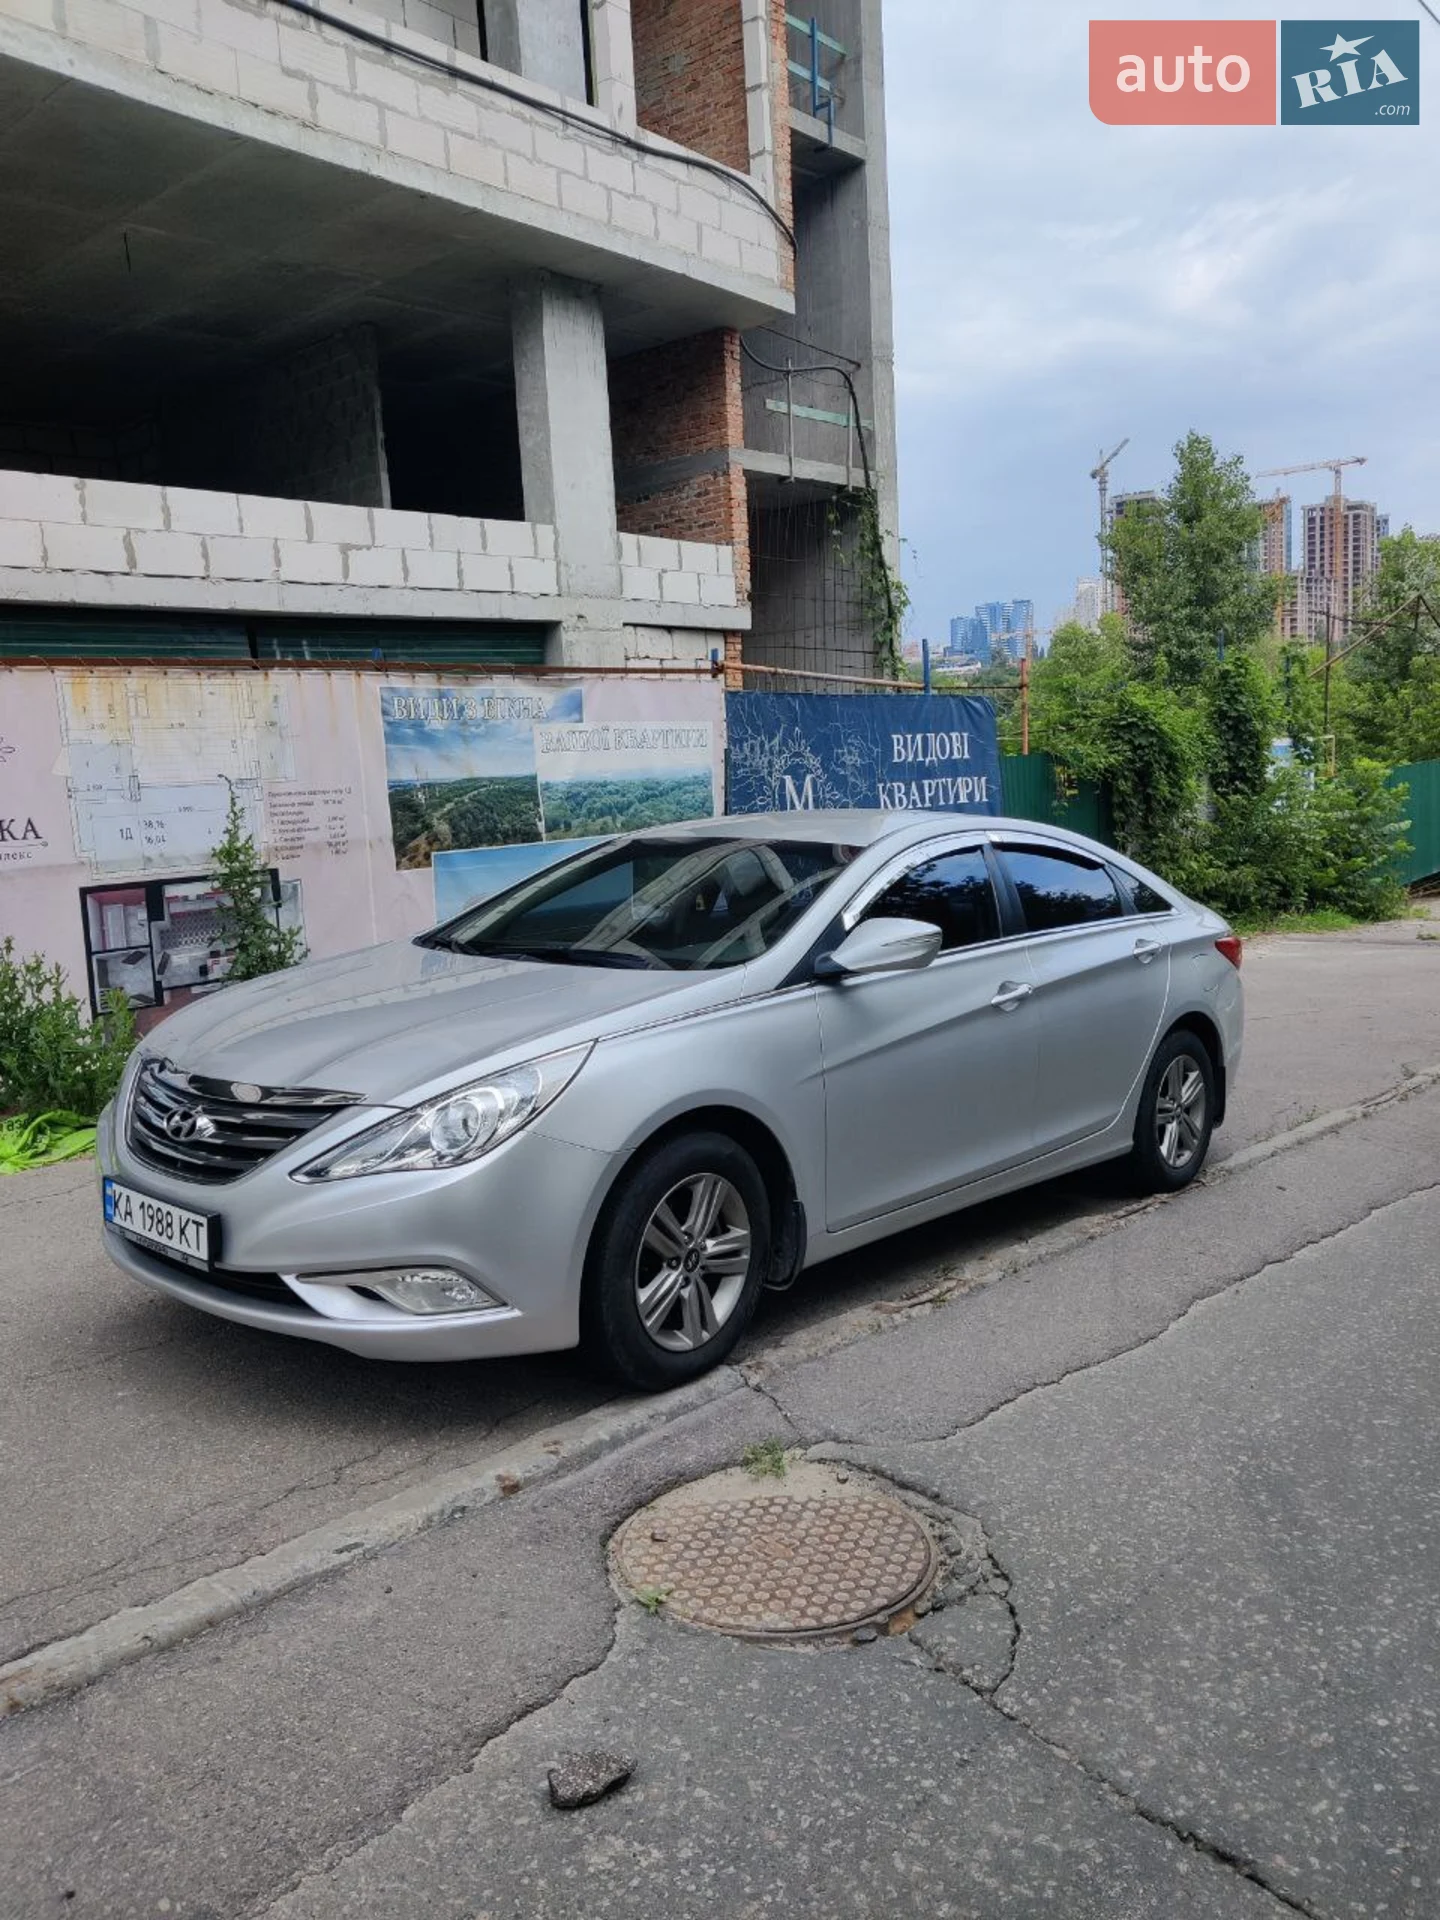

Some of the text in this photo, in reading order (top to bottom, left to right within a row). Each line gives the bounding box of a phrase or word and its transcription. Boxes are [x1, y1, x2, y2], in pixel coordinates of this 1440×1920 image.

[393, 696, 463, 724] ВИДИ
[484, 696, 549, 719] ВІКНА
[892, 732, 970, 766] ВИДОВІ
[877, 776, 988, 811] КВАРТИРИ
[113, 1189, 134, 1225] KA
[139, 1201, 174, 1241] 1988
[179, 1215, 205, 1252] KT
